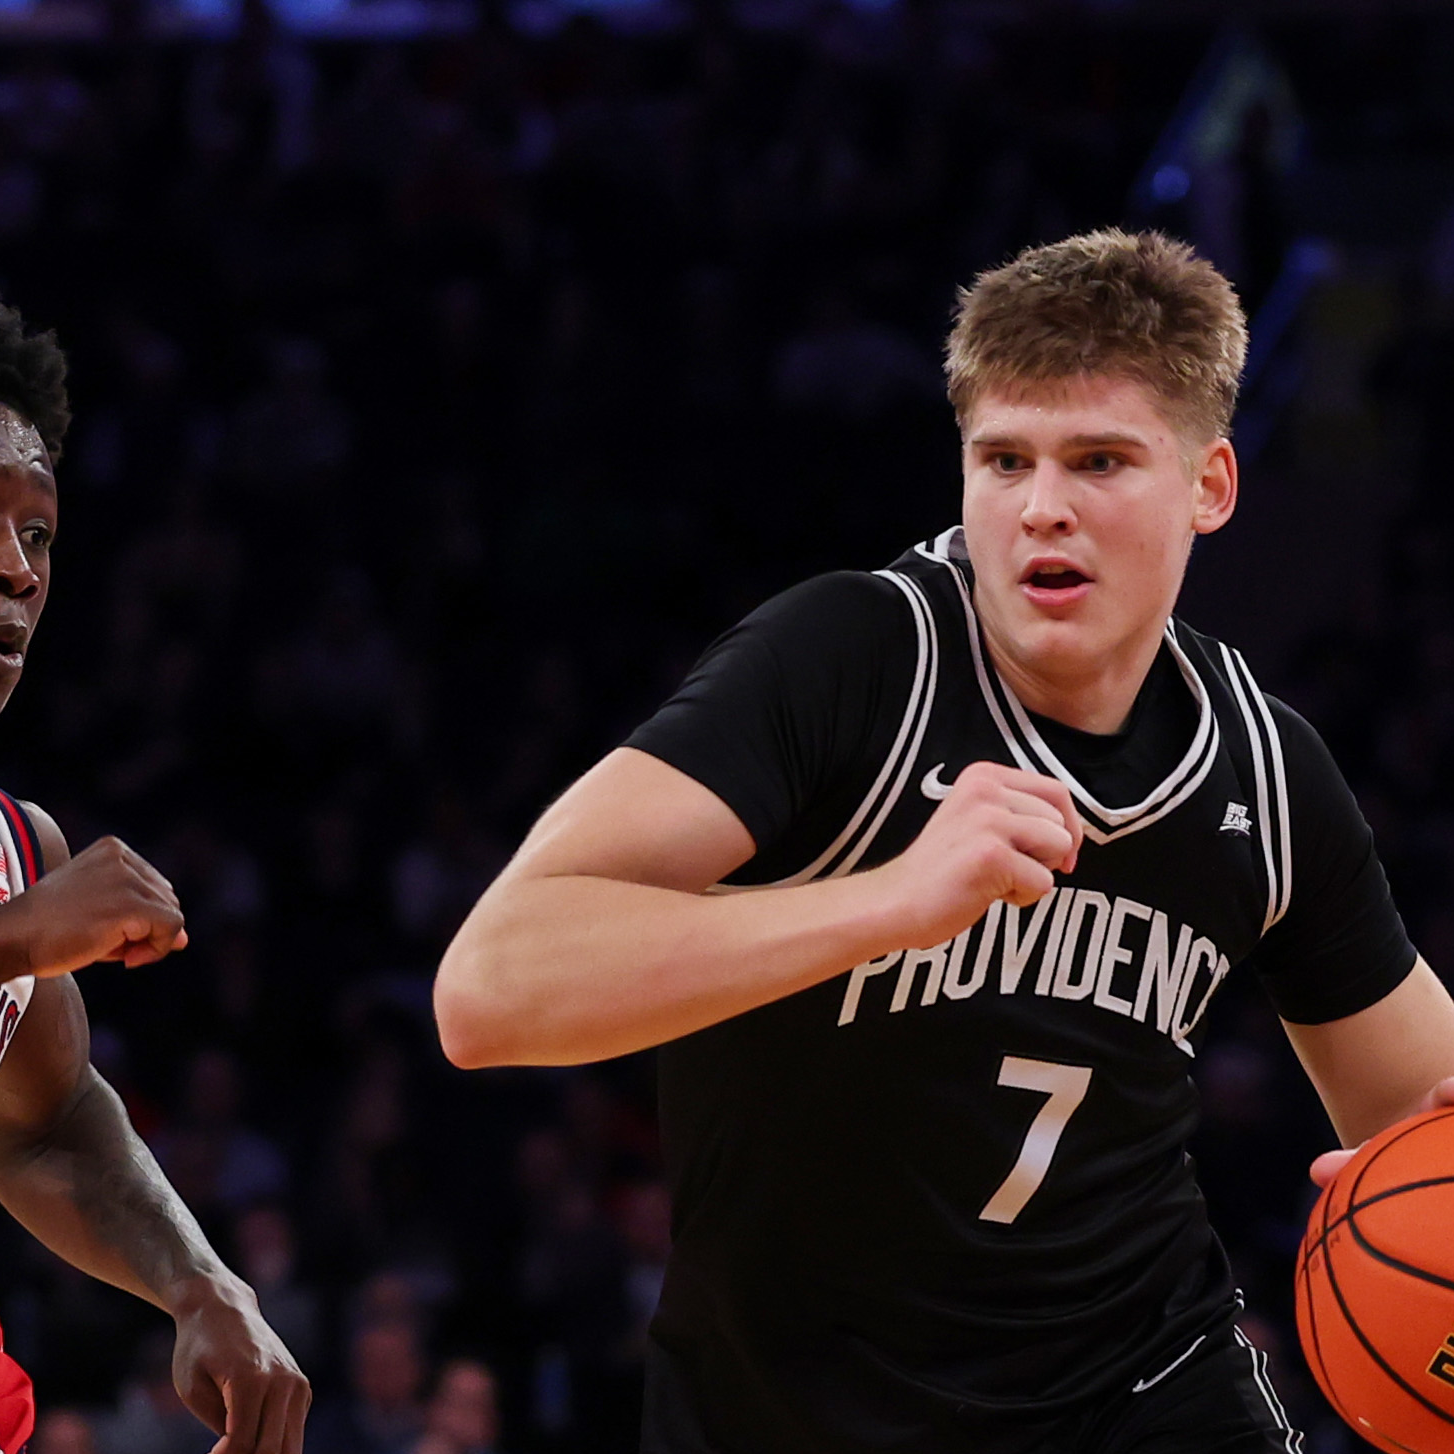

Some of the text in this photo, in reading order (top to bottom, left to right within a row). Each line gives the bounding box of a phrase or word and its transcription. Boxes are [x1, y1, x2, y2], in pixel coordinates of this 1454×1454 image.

[1222, 813, 1253, 832] EAST
[1226, 801, 1249, 817] BIG
[837, 886, 1231, 1059] PROVIDENC
[977, 1054, 1094, 1225] 7
